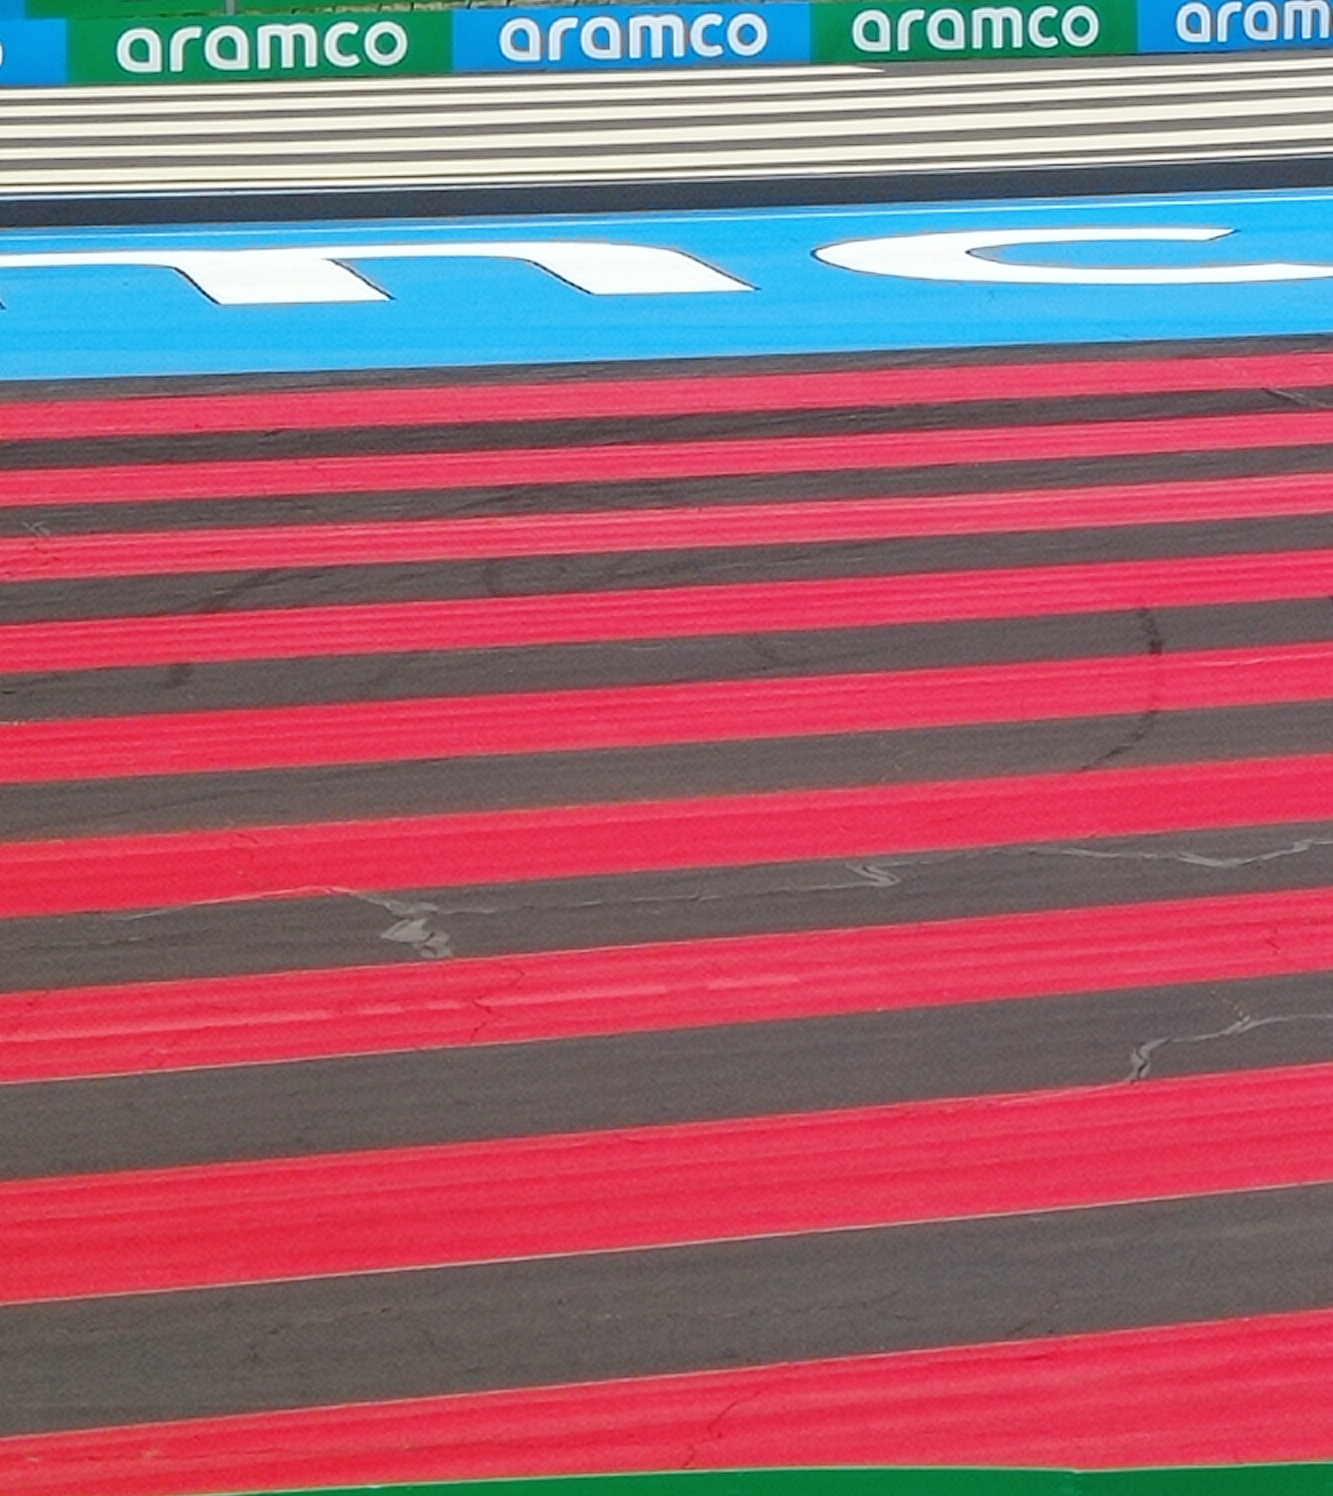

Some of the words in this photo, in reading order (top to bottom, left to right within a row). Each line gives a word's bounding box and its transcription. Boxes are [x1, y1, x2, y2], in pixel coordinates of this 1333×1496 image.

[118, 21, 408, 72] aramco
[501, 12, 768, 62] aramco
[853, 5, 1099, 52] aramco
